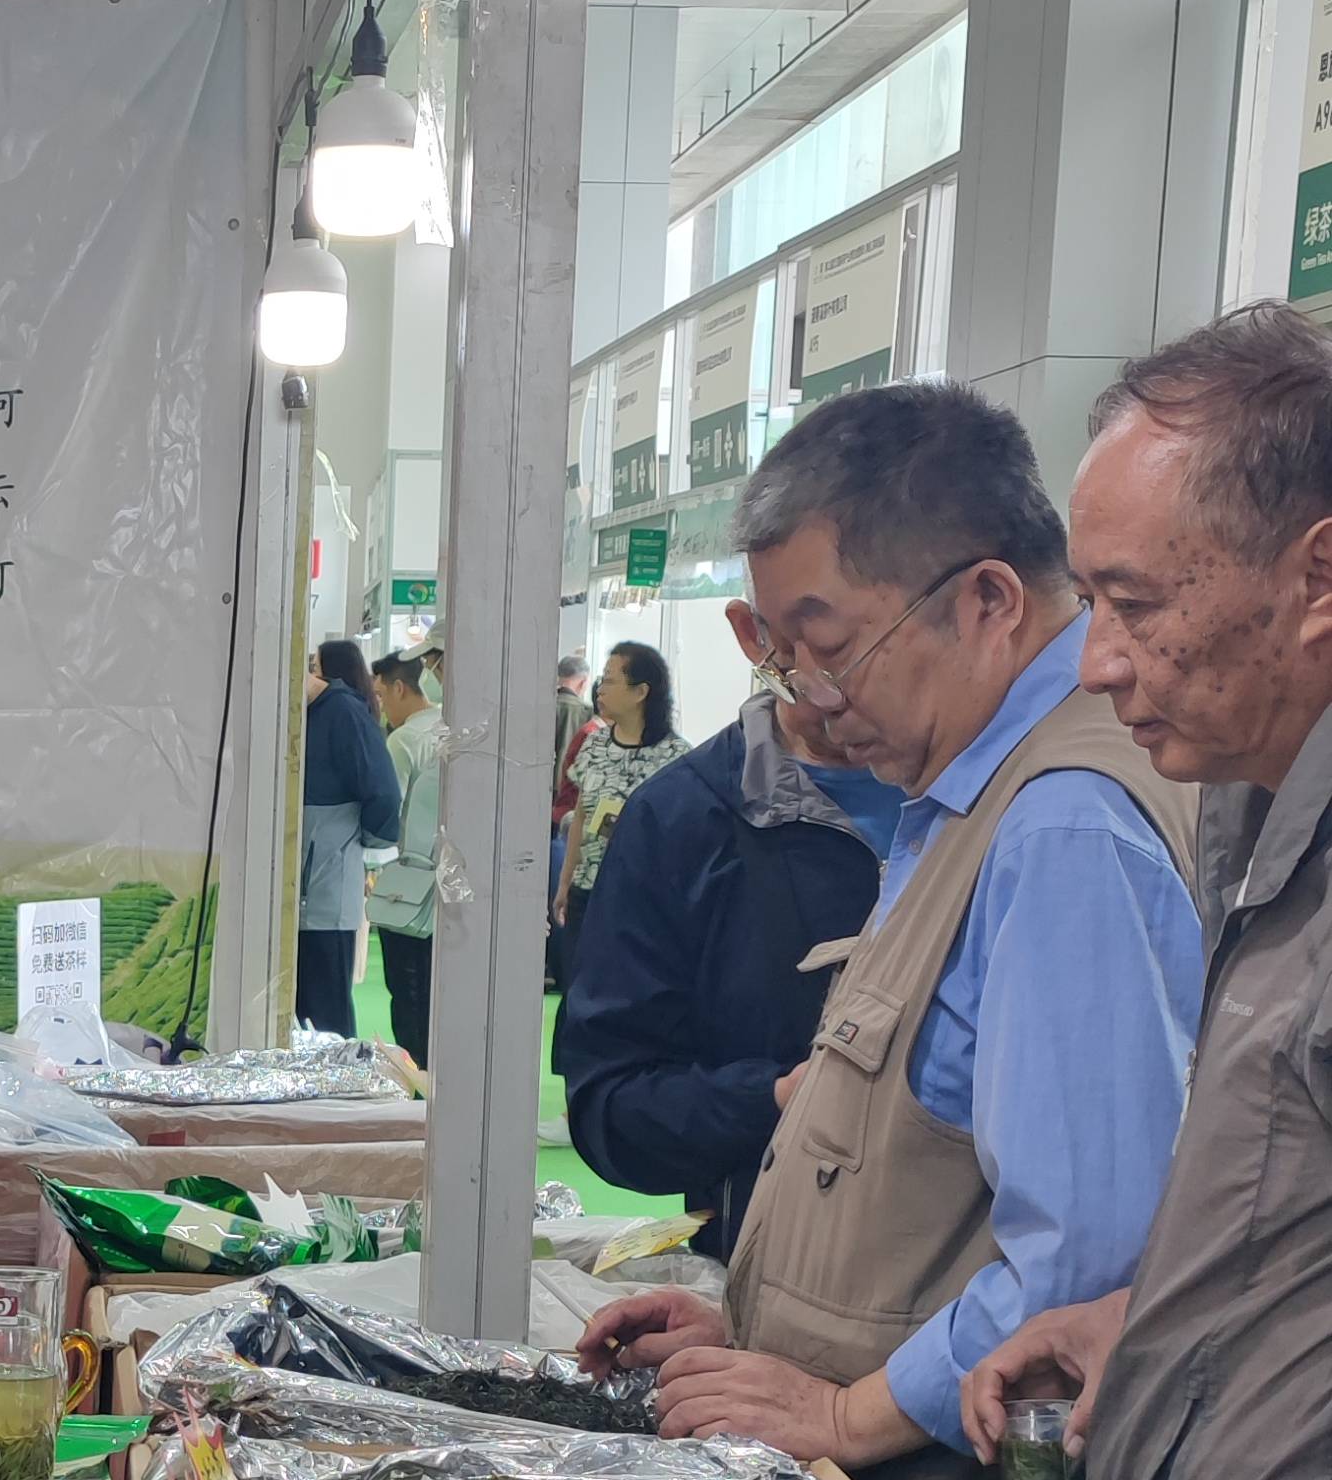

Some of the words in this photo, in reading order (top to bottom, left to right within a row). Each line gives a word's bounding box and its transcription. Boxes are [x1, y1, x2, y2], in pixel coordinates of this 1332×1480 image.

[31, 920, 88, 946] 扫码加微信
[31, 948, 88, 974] 免费送茶样
